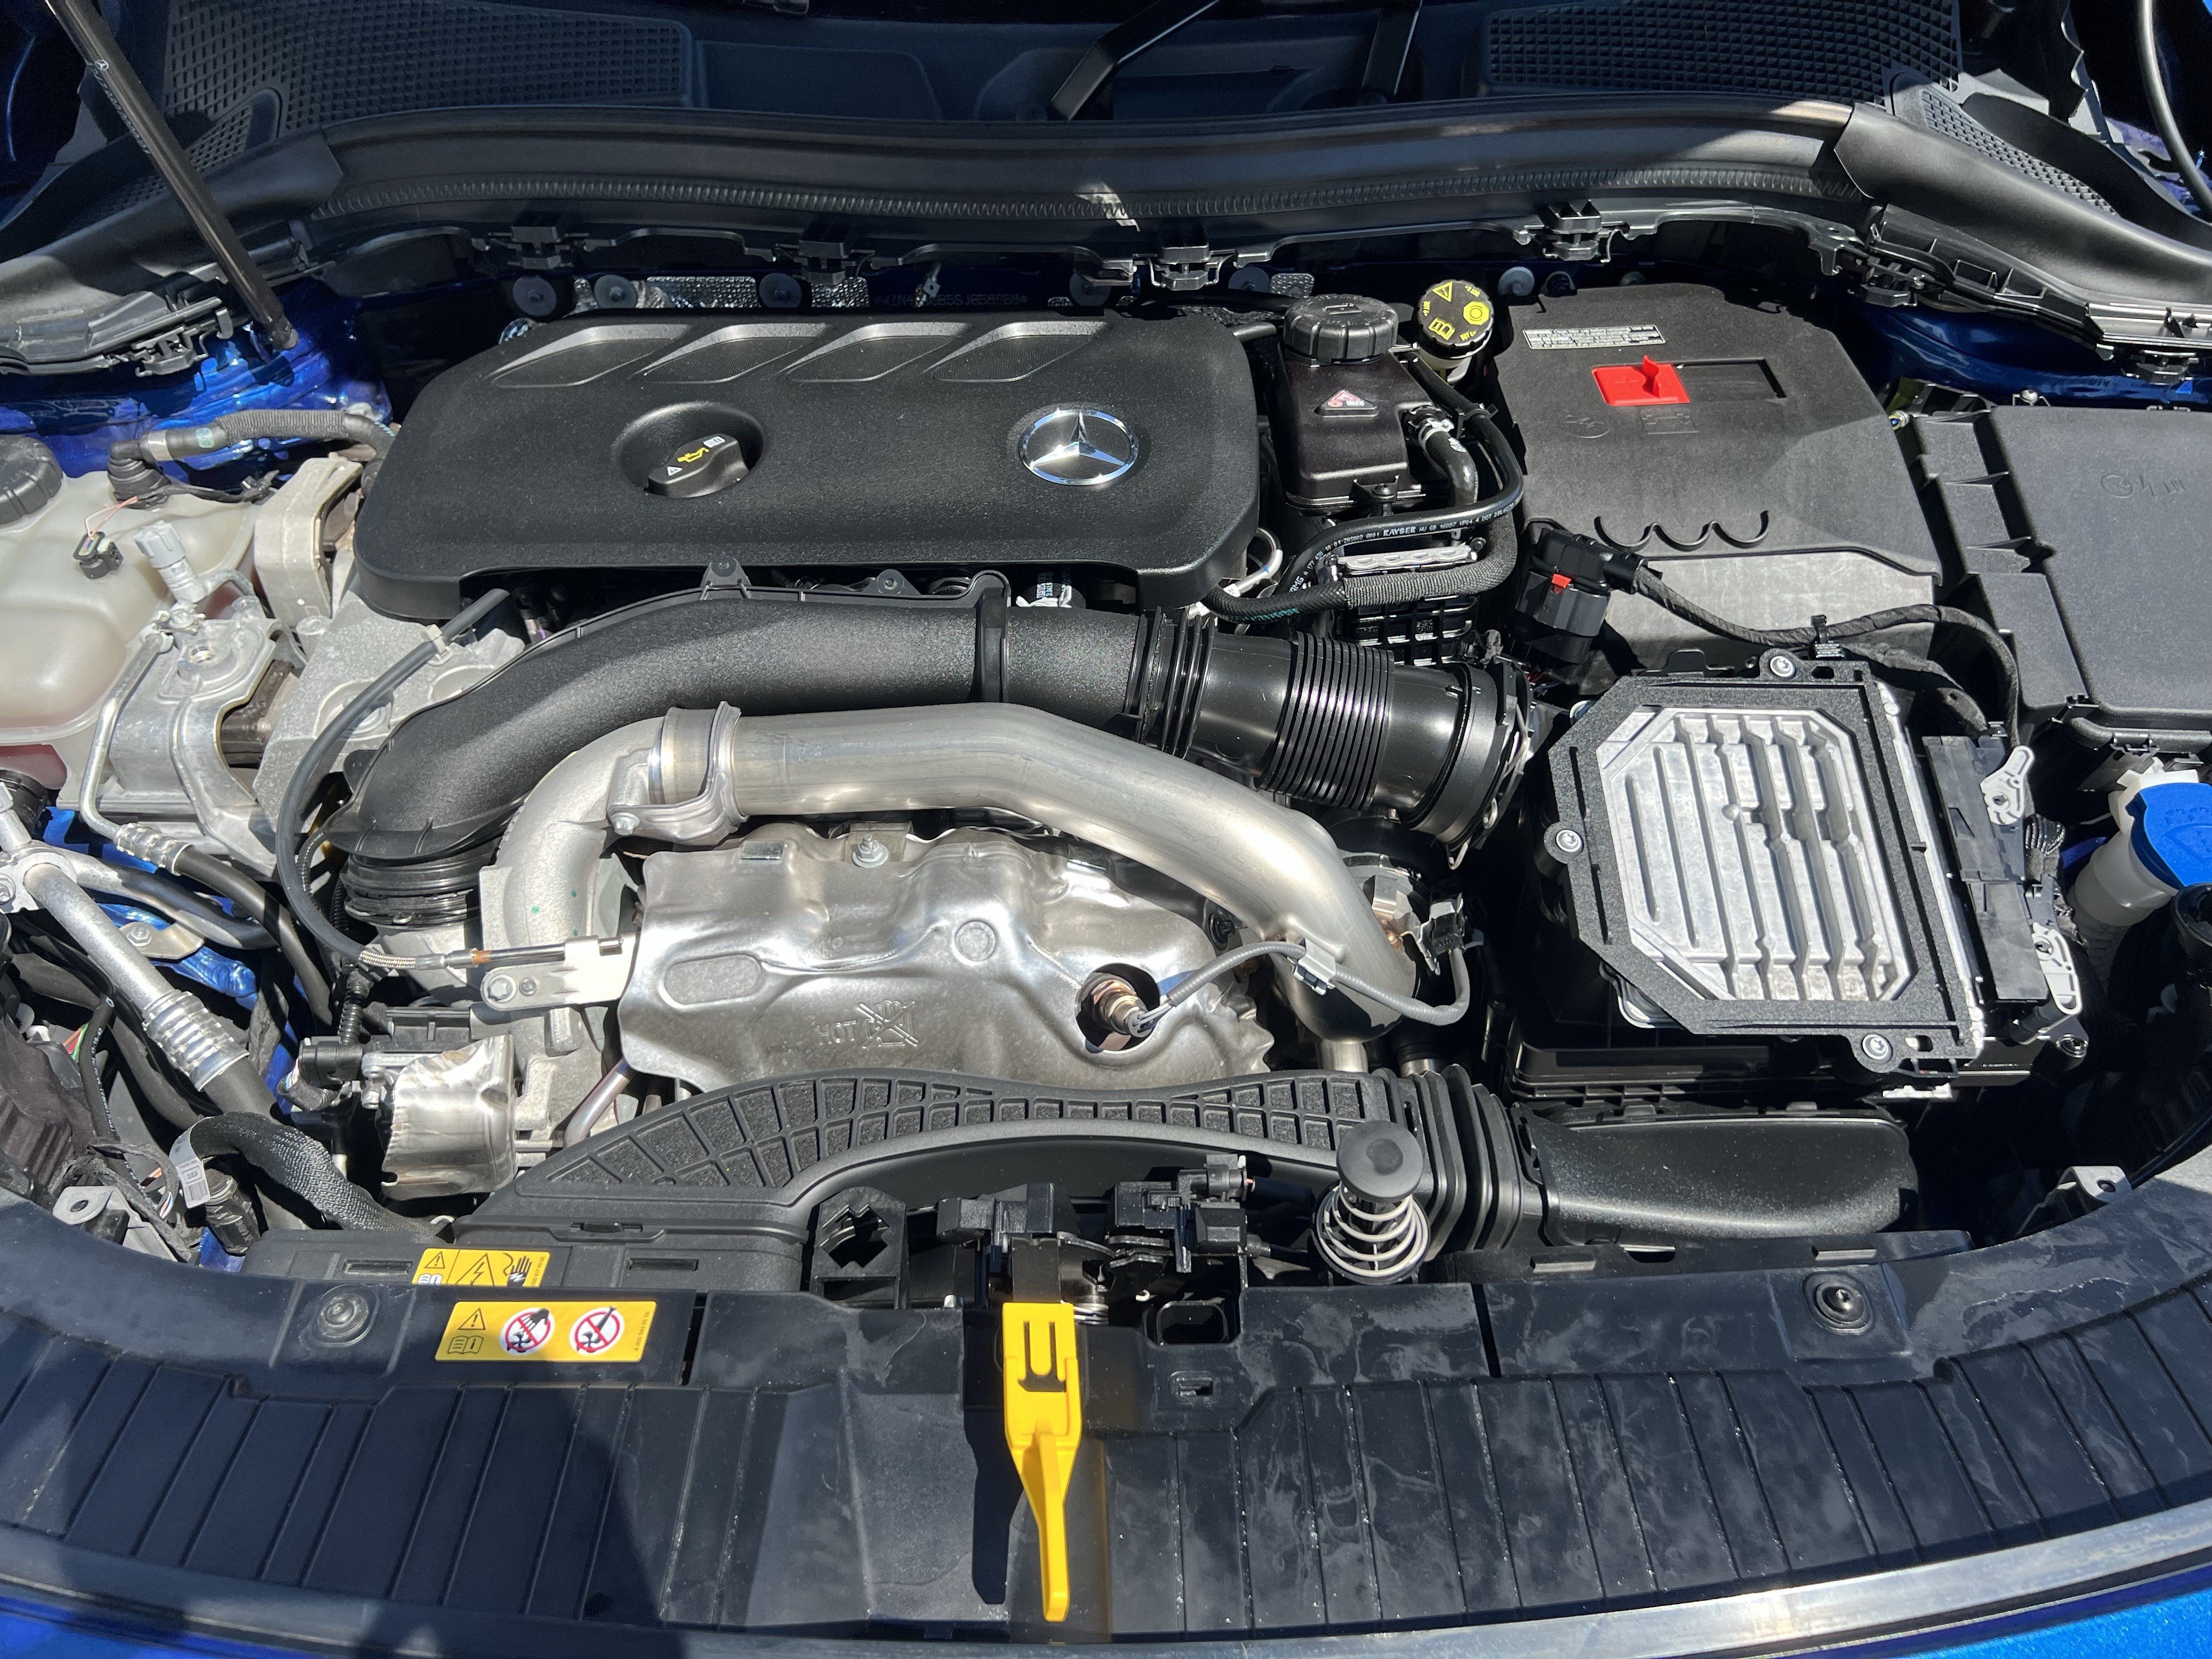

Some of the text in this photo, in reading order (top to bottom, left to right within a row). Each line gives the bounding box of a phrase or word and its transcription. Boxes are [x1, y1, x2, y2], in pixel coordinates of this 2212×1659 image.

[1289, 575, 1305, 592] AMG
[1307, 560, 1315, 569] 177
[1314, 551, 1324, 561] 430
[1383, 526, 1416, 536] KAYSER
[816, 1019, 857, 1045] HOT
